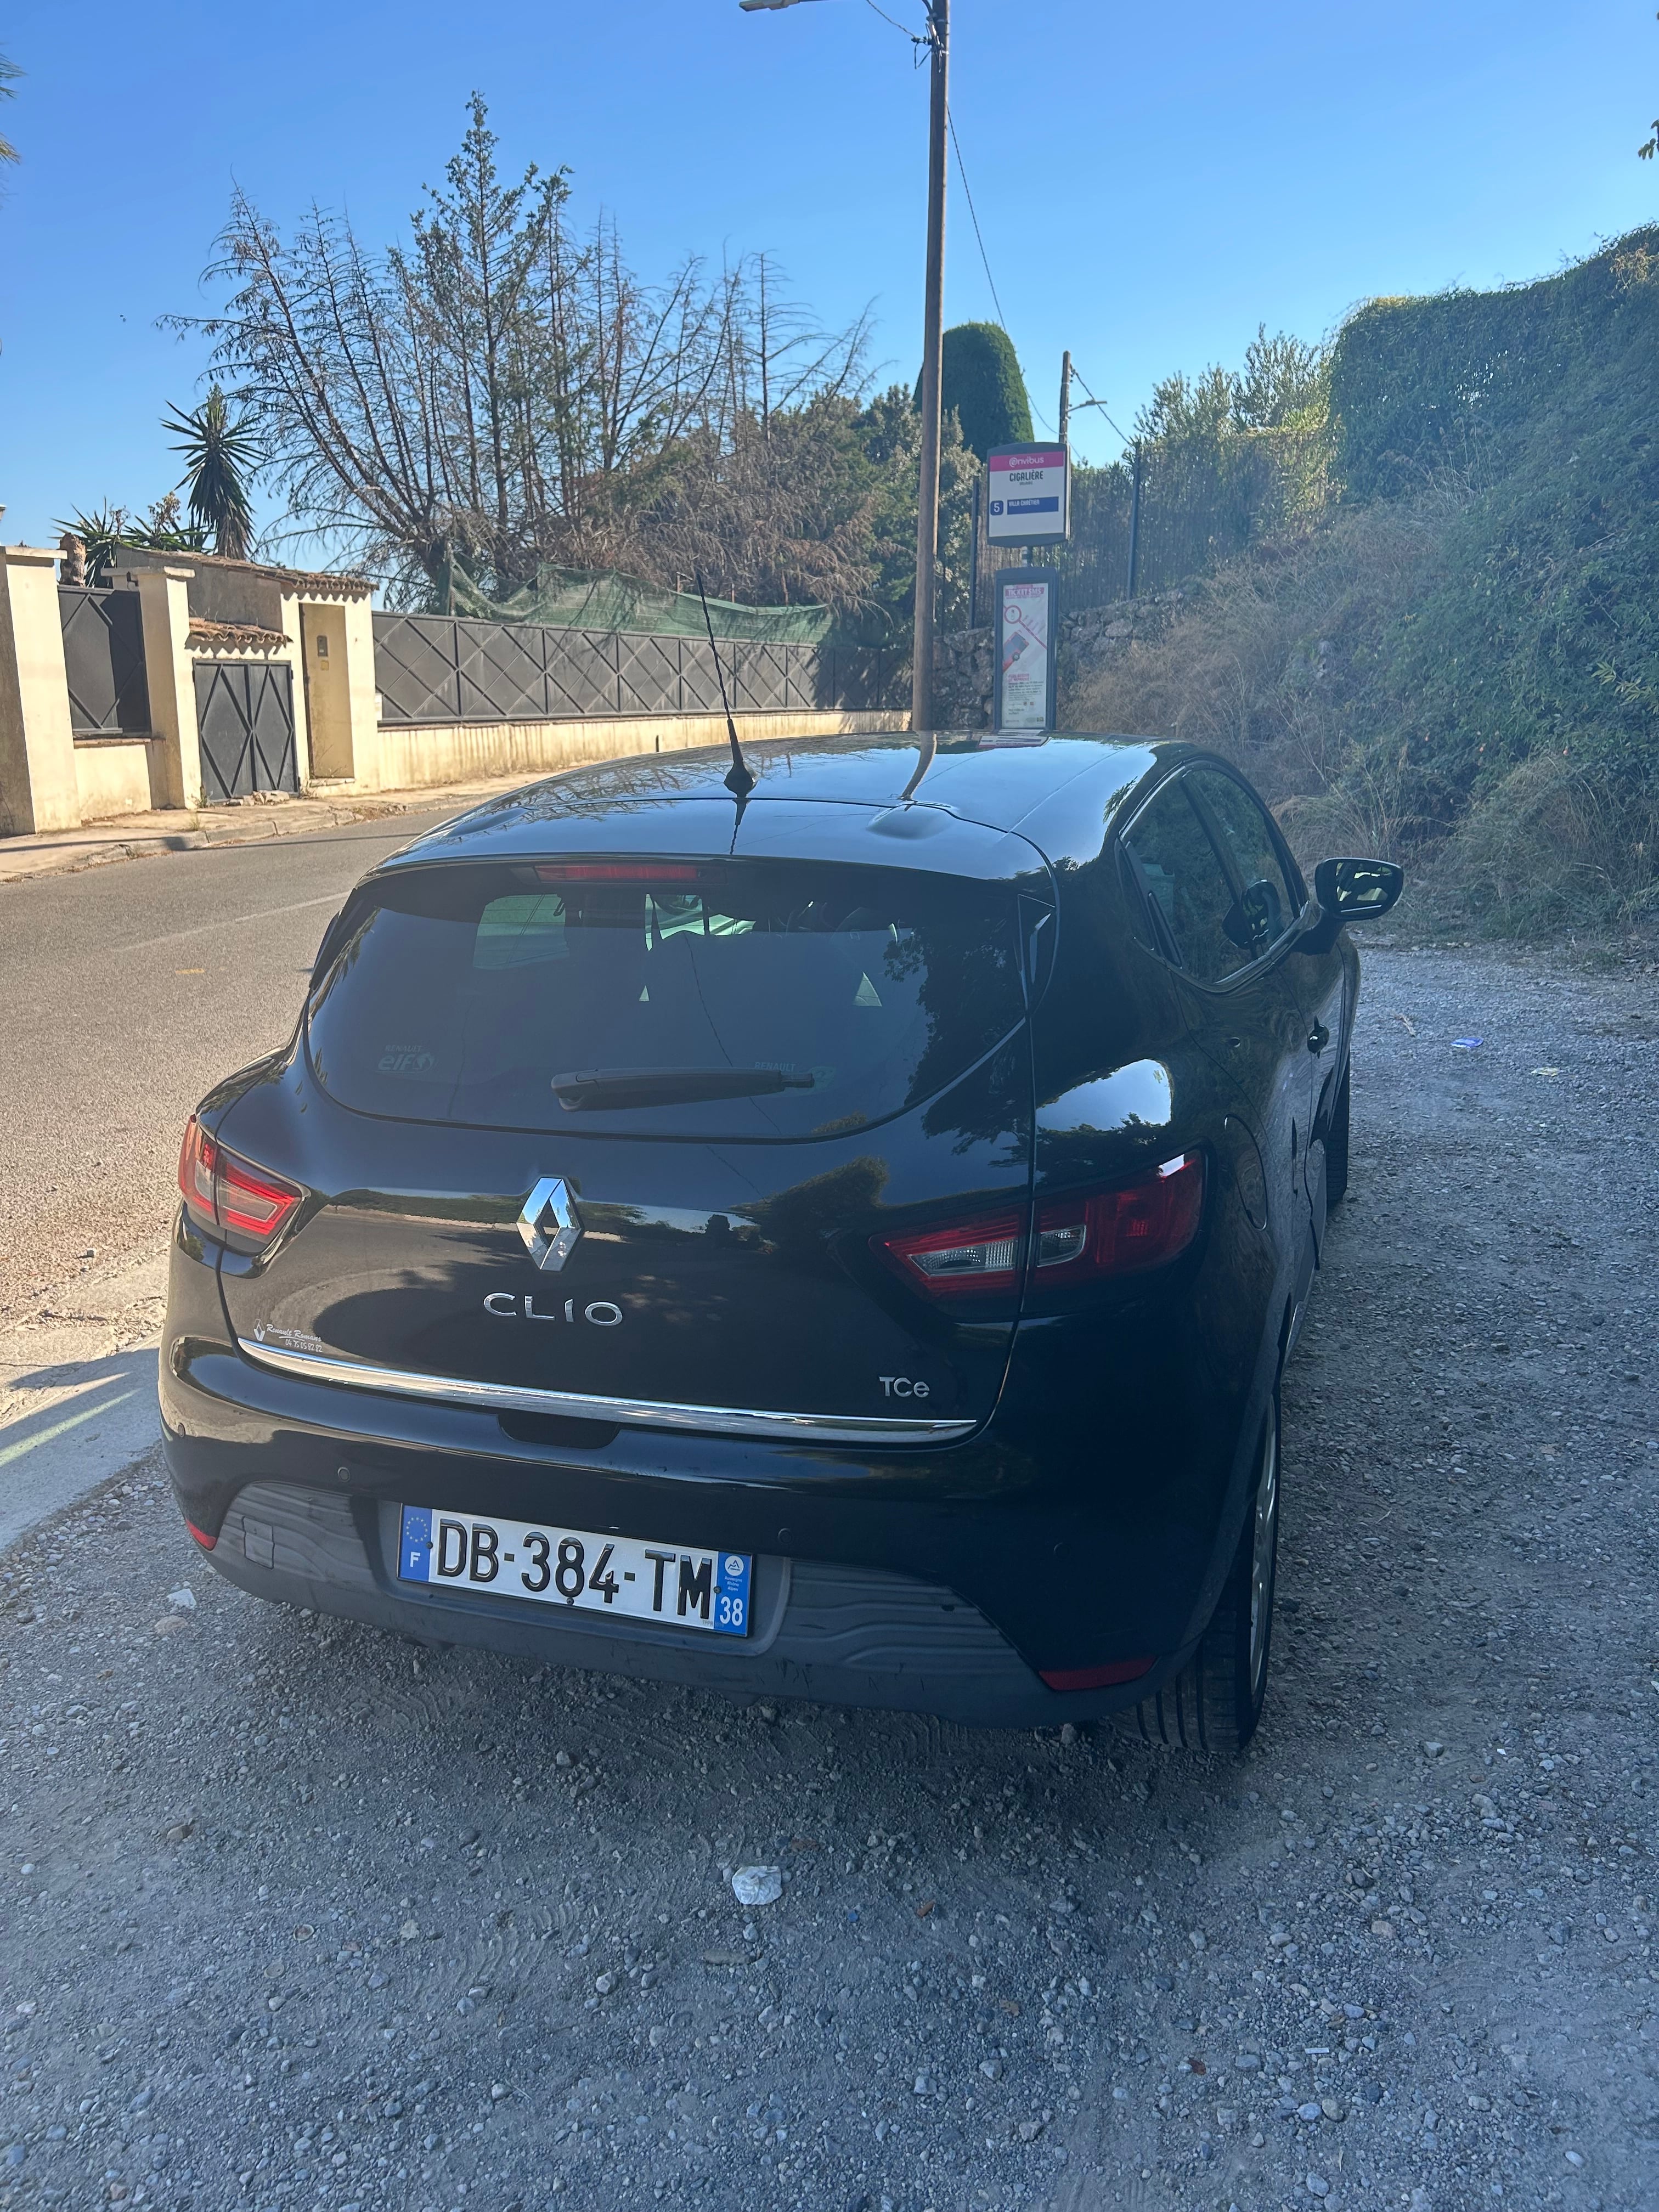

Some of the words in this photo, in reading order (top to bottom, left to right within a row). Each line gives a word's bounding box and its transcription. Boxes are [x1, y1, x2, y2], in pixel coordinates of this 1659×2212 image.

[1009, 469, 1043, 482] CIGALIÈRE
[994, 503, 1000, 512] 5
[483, 1293, 623, 1327] CLIO
[266, 1323, 292, 1336] Renault
[294, 1329, 322, 1342] Romans
[308, 1342, 315, 1351] 82
[315, 1344, 323, 1352] 82
[879, 1376, 930, 1398] TCe
[409, 1551, 420, 1567] F
[437, 1518, 713, 1619] DB-384-TM
[720, 1596, 743, 1627] 38
